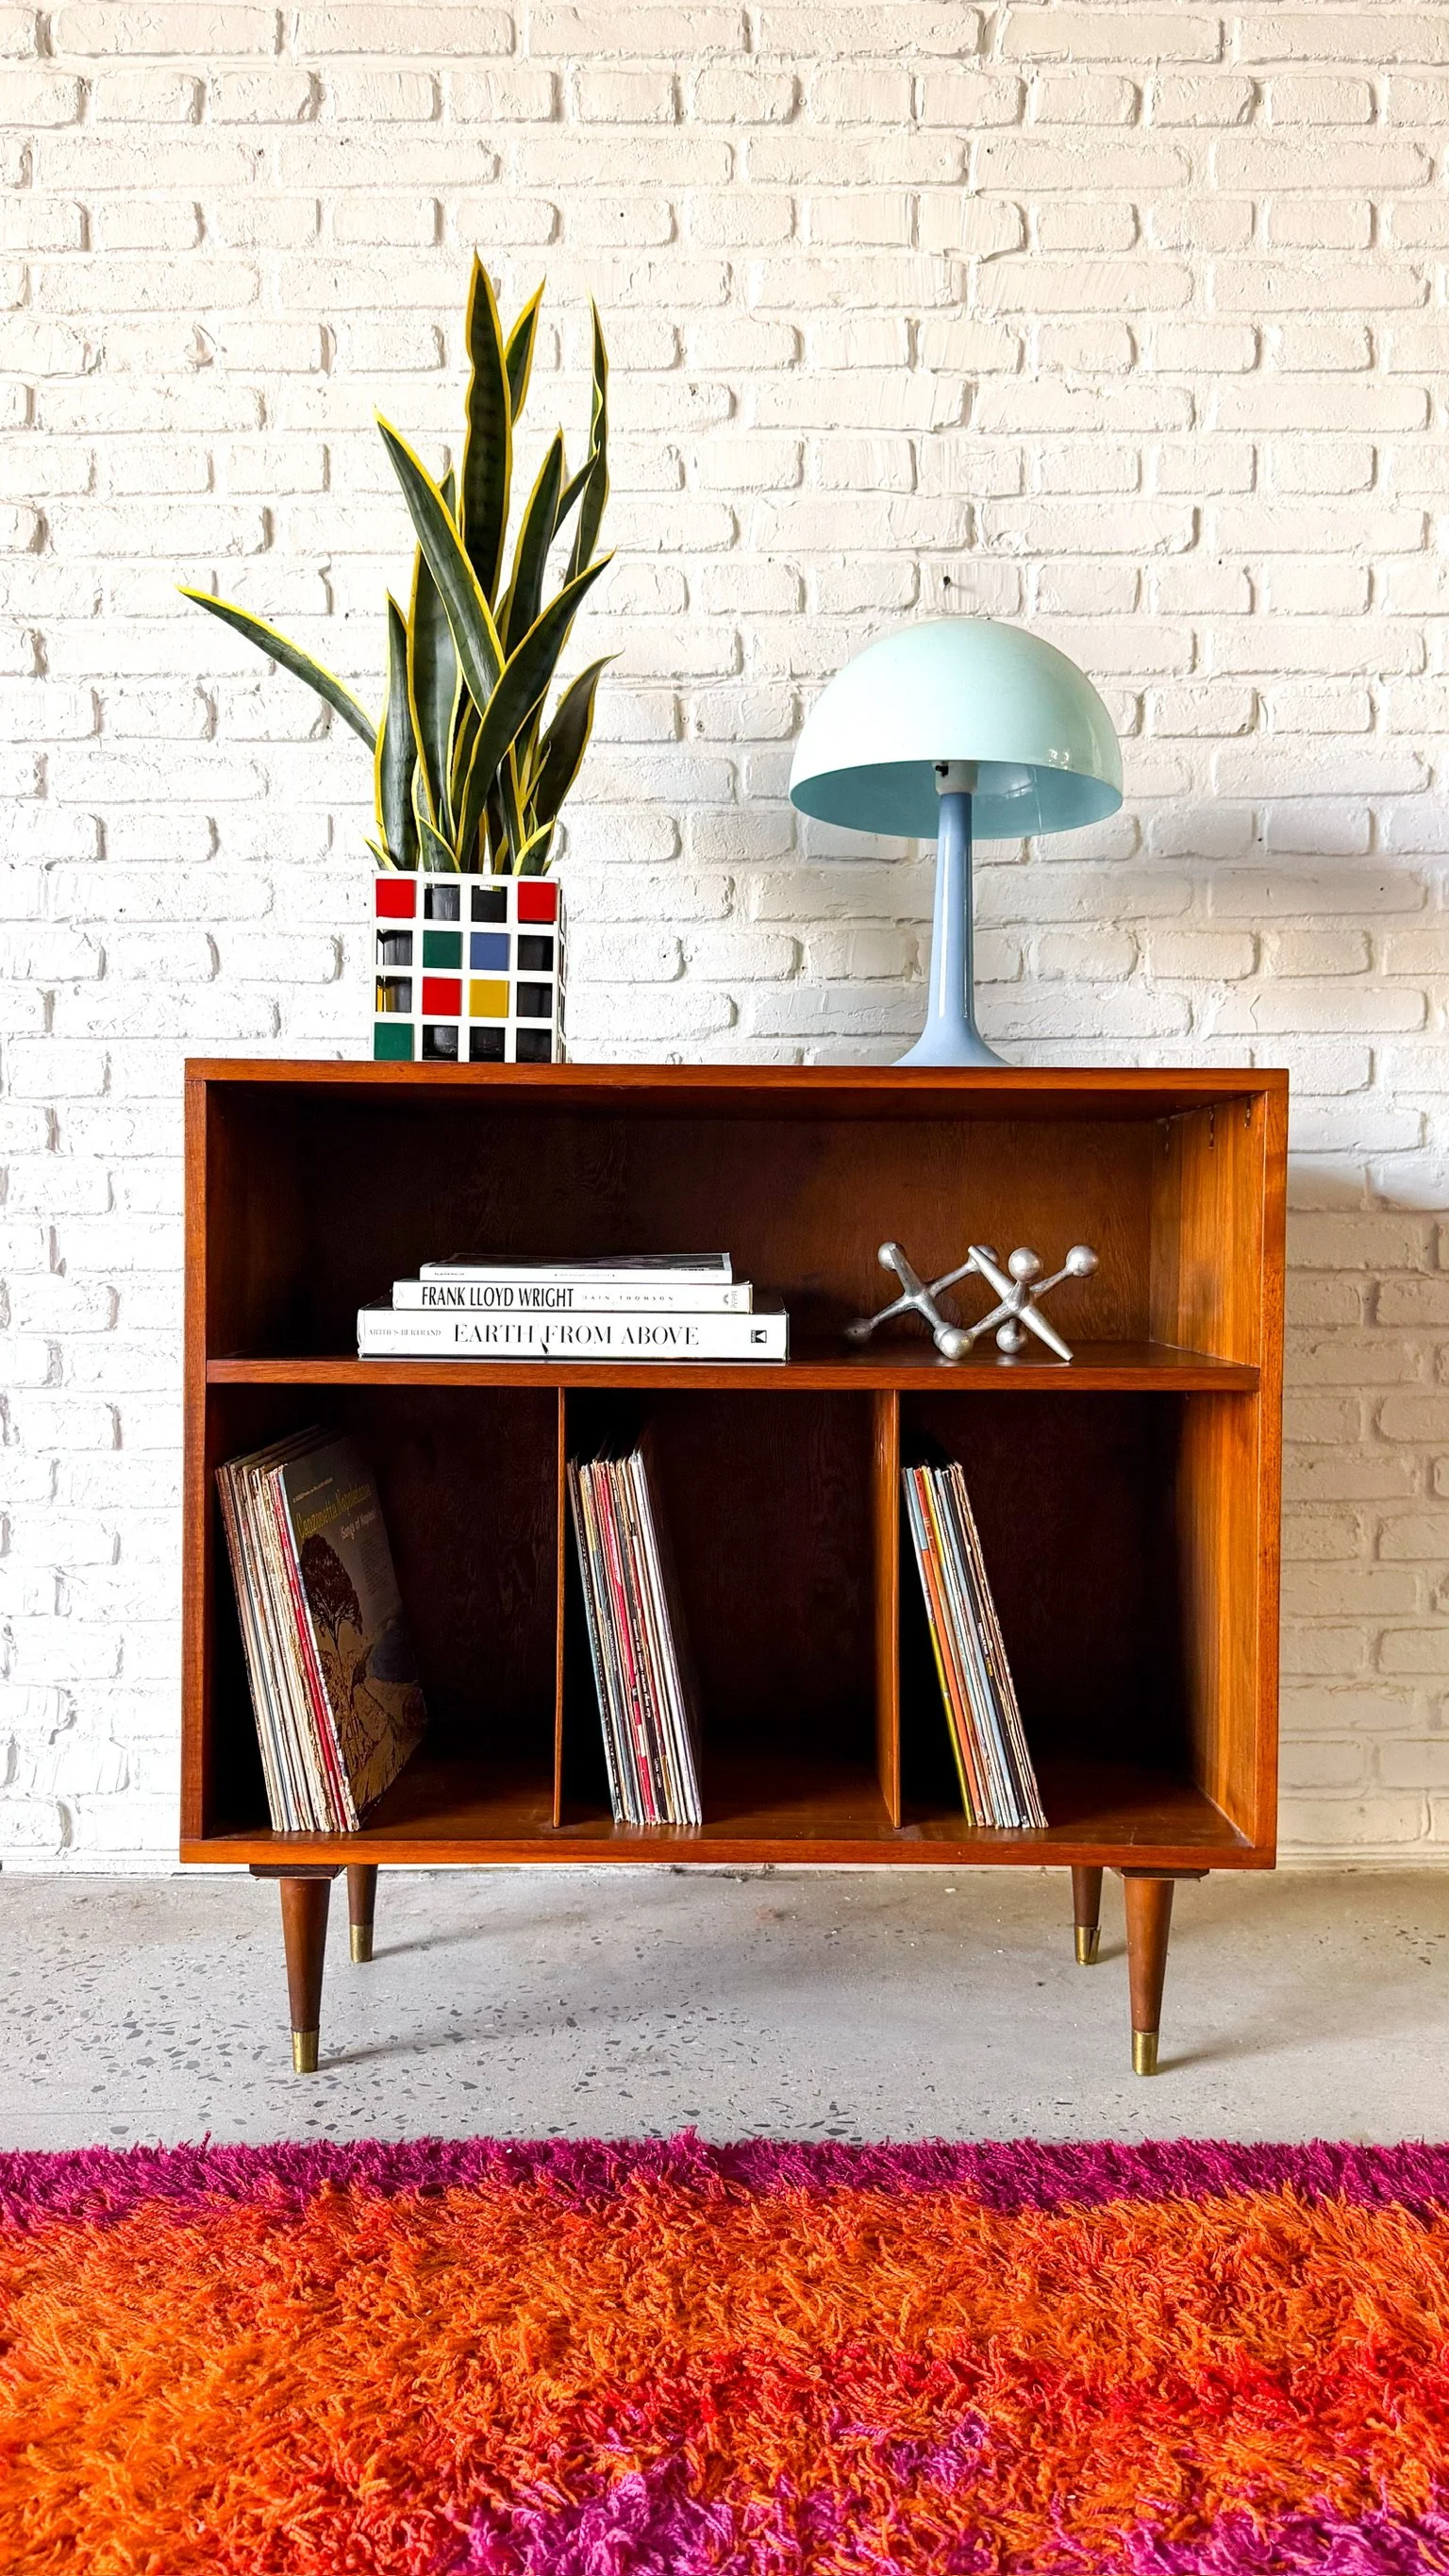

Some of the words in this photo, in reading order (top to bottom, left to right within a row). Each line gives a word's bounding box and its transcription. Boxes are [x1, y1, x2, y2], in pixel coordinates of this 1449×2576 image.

[422, 1286, 466, 1306] FRANK
[470, 1286, 514, 1307] LLOYD
[518, 1287, 575, 1308] WRIGHT
[454, 1323, 534, 1343] EARTH
[544, 1325, 612, 1344] FROM
[621, 1326, 700, 1346] ABOVE
